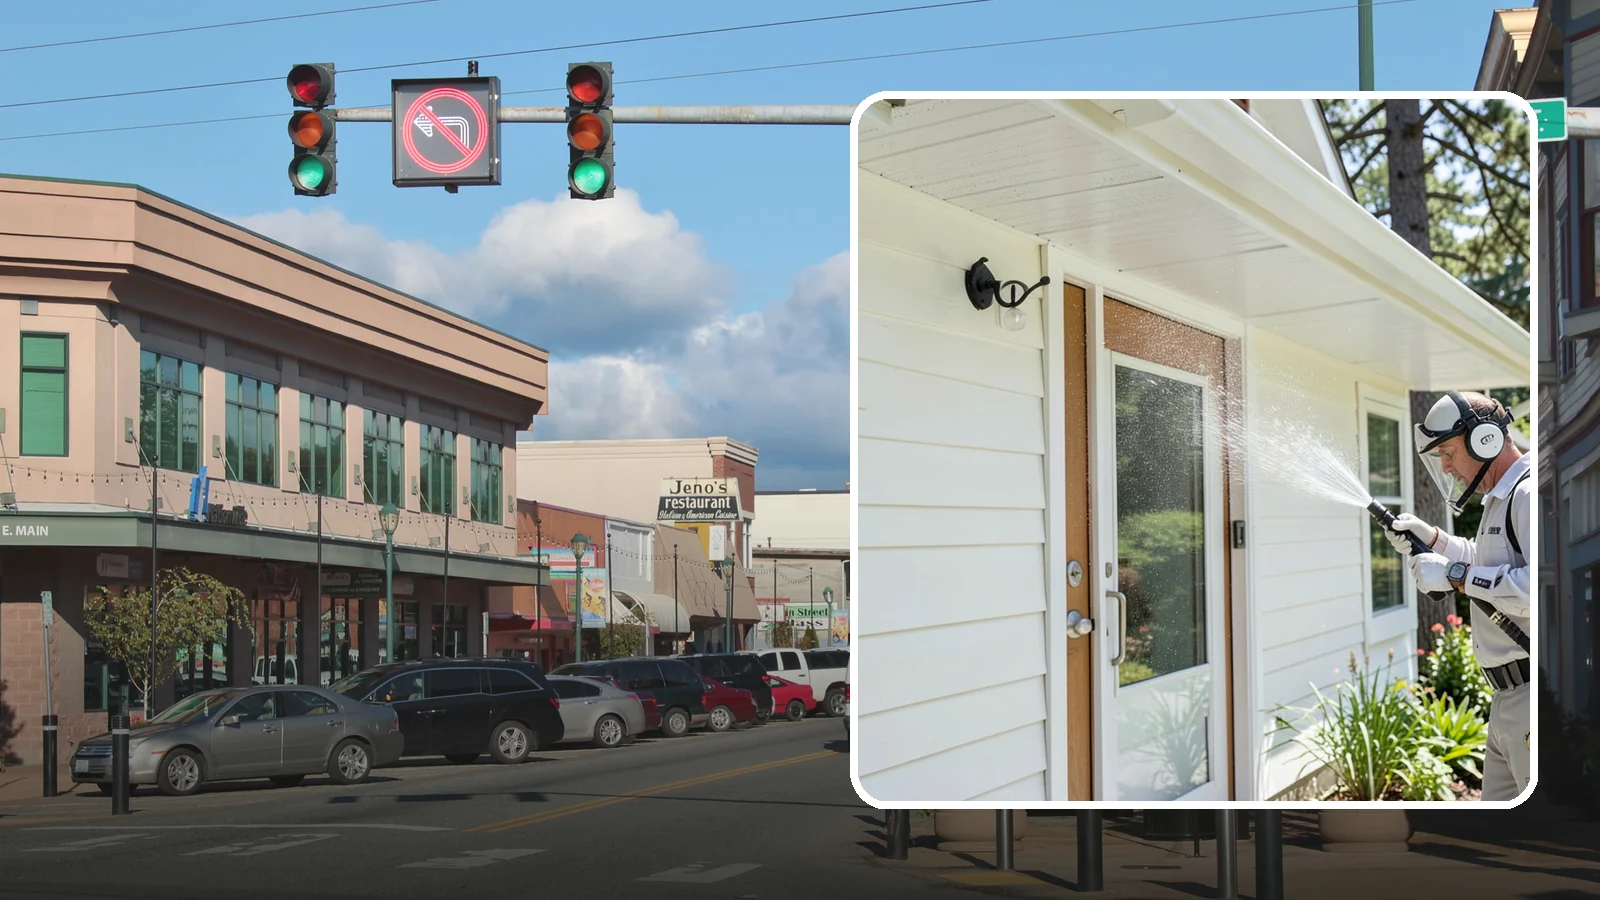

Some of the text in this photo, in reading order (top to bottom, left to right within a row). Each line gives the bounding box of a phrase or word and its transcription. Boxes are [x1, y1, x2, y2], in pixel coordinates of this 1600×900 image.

[669, 480, 727, 495] Jeno's
[665, 496, 731, 509] restaurant
[686, 509, 714, 519] American
[715, 509, 737, 519] Cuisine
[2, 525, 49, 536] E. MAIN
[797, 607, 828, 616] Street
